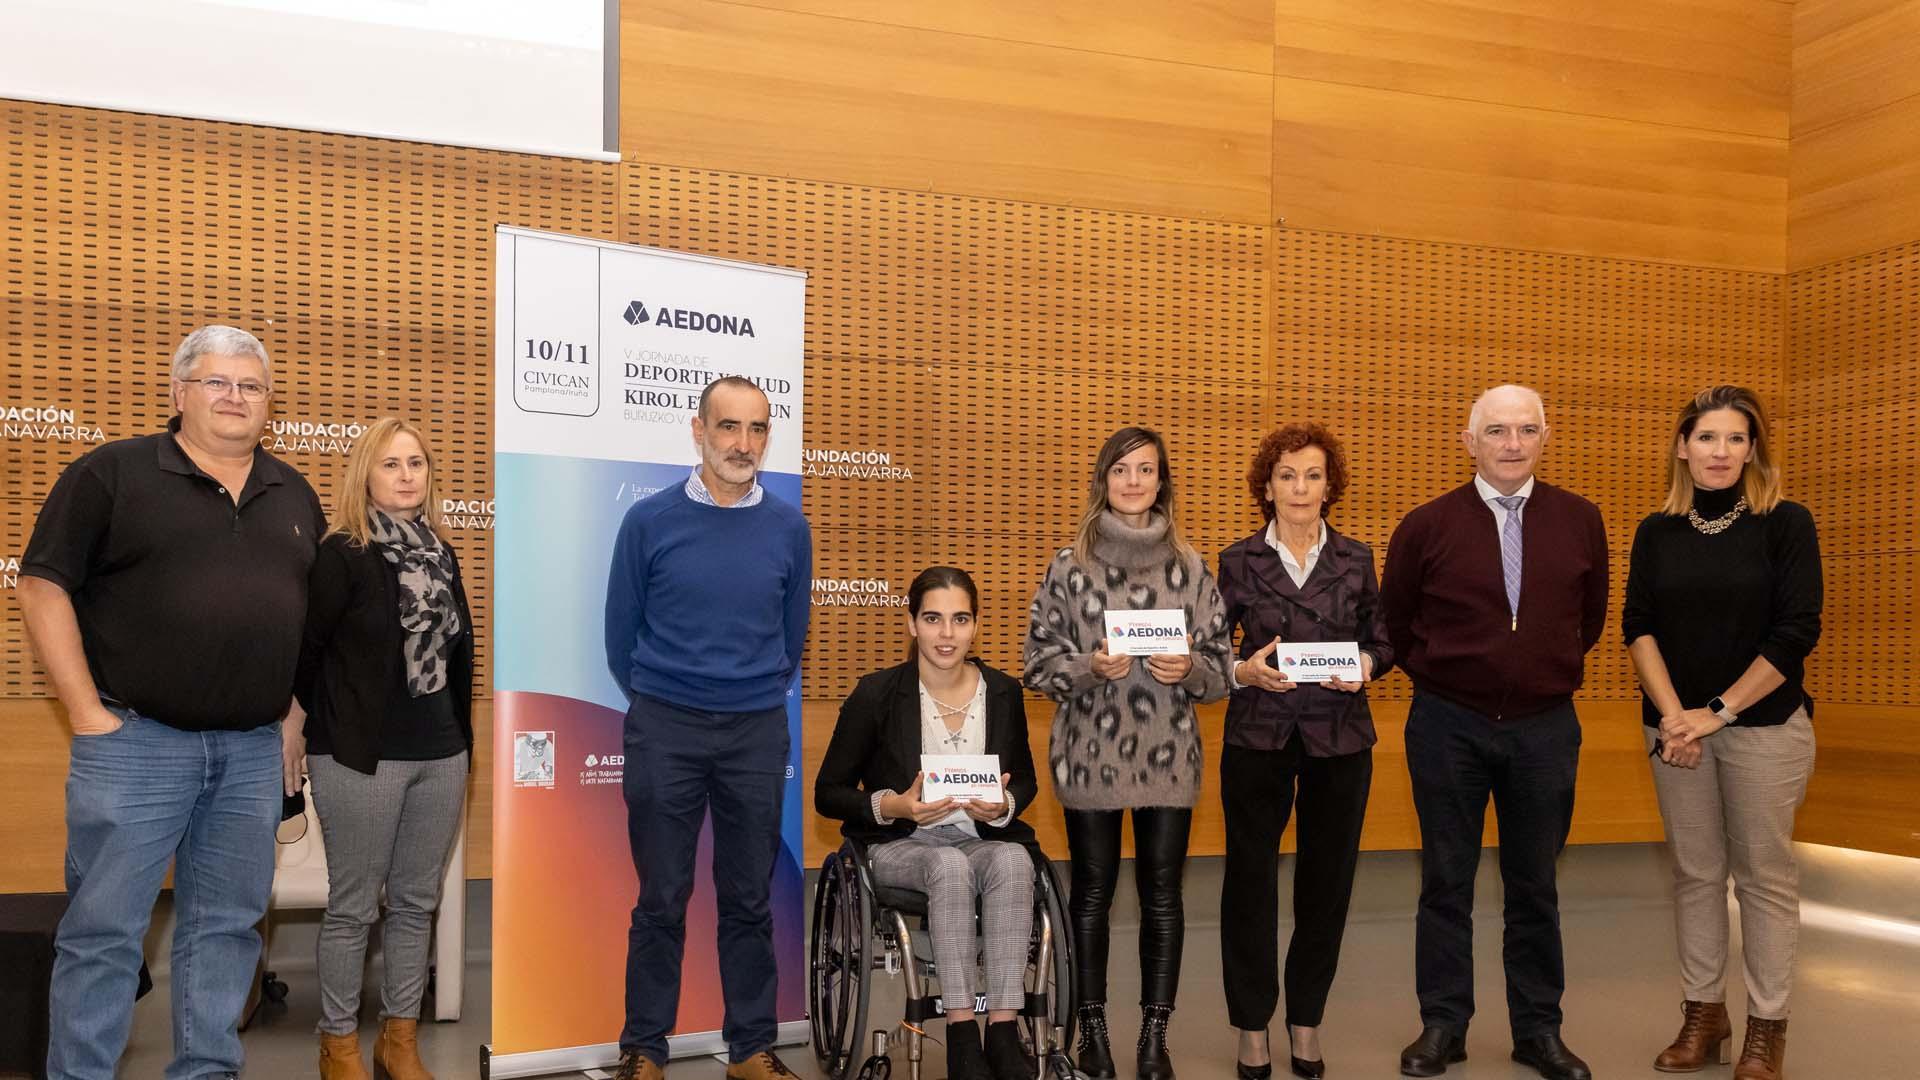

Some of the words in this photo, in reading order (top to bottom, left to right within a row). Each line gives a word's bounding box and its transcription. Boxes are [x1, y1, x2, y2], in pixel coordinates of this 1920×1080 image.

[655, 307, 755, 338] AEDONA
[525, 338, 590, 365] 10/11
[636, 350, 690, 366] JORNADA
[694, 356, 710, 368] DE
[523, 370, 590, 389] CIVICAN
[624, 362, 714, 386] DEPORTE
[624, 389, 683, 409] KIROL
[687, 395, 701, 411] E
[624, 408, 674, 424] BURUZKO
[0, 423, 106, 442] NAVARRA
[265, 420, 369, 439] UNDACIÓ
[260, 435, 353, 454] CAJANAV
[1127, 627, 1184, 638] AEDONA
[1299, 657, 1357, 667] AEDONA
[943, 773, 998, 784] AEDONA
